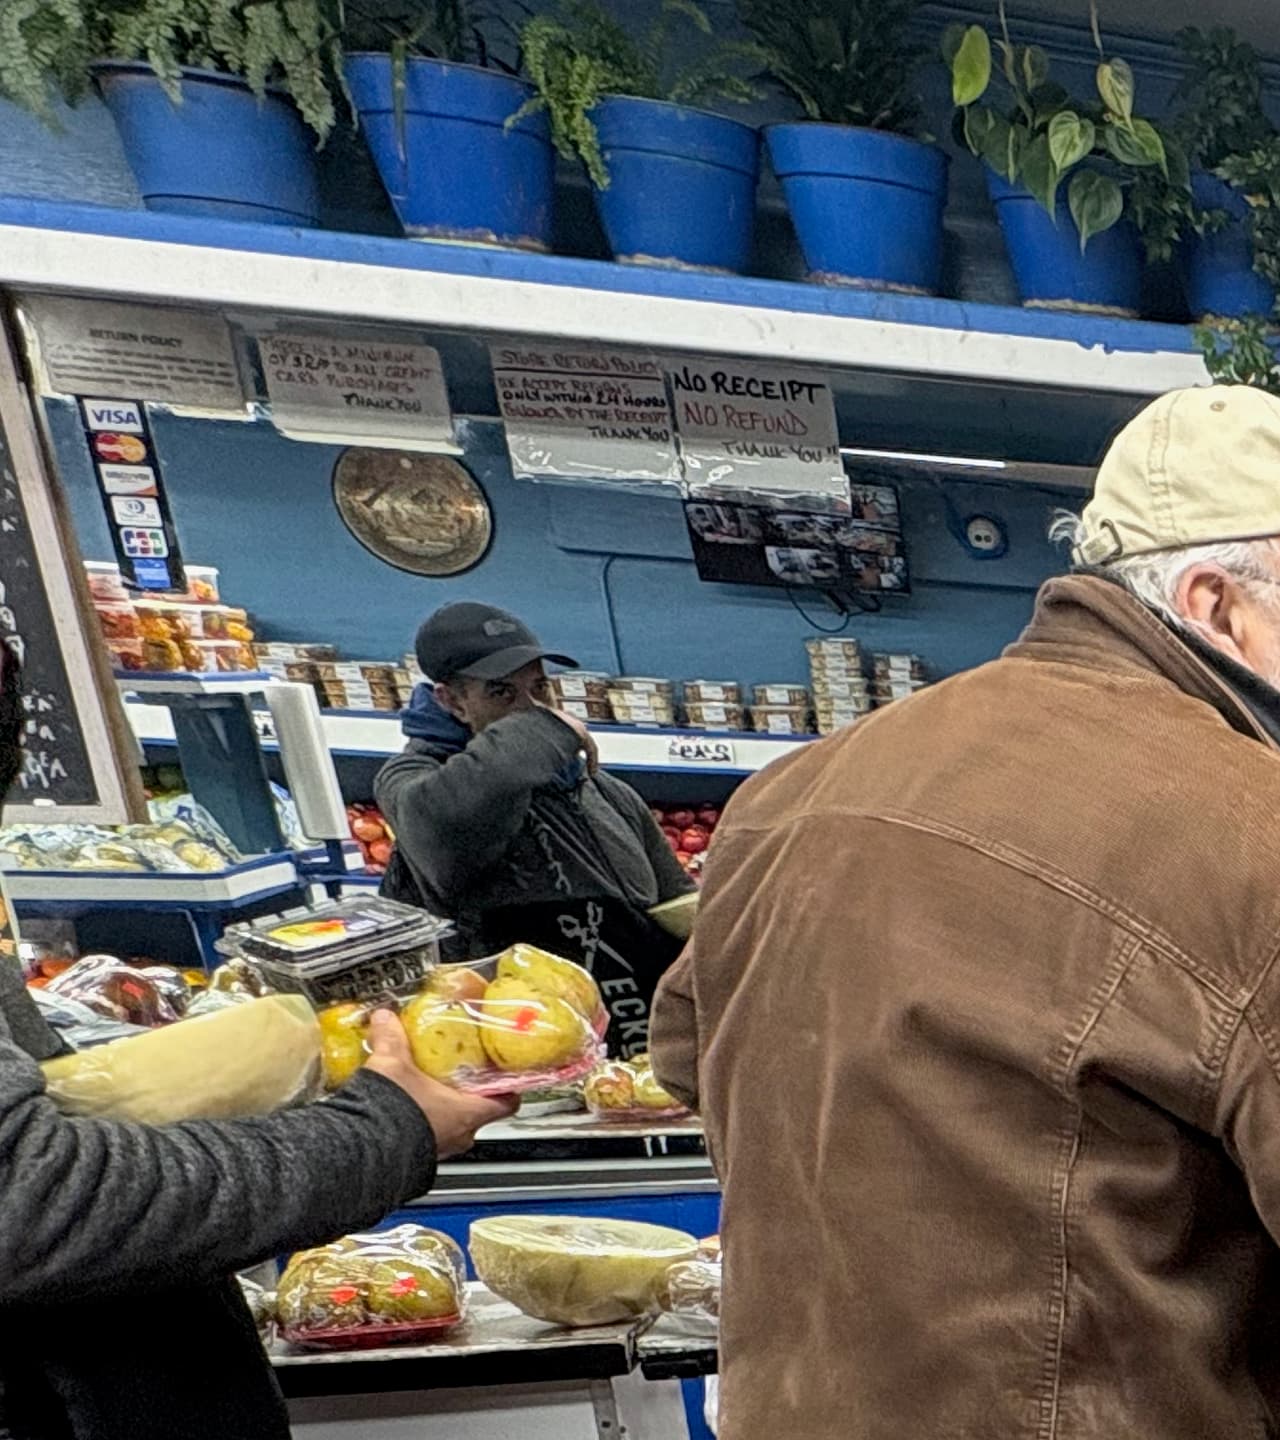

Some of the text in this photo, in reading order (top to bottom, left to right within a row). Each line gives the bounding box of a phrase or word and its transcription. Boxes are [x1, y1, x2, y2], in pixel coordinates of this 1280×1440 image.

[88, 327, 139, 344] RETURN
[673, 365, 827, 406] NO RECEIPT
[502, 389, 540, 403] ONLY
[91, 408, 138, 426] VISA
[683, 400, 809, 437] NO REFUND
[587, 425, 670, 442] THANK YOU
[720, 440, 789, 460] THANK
